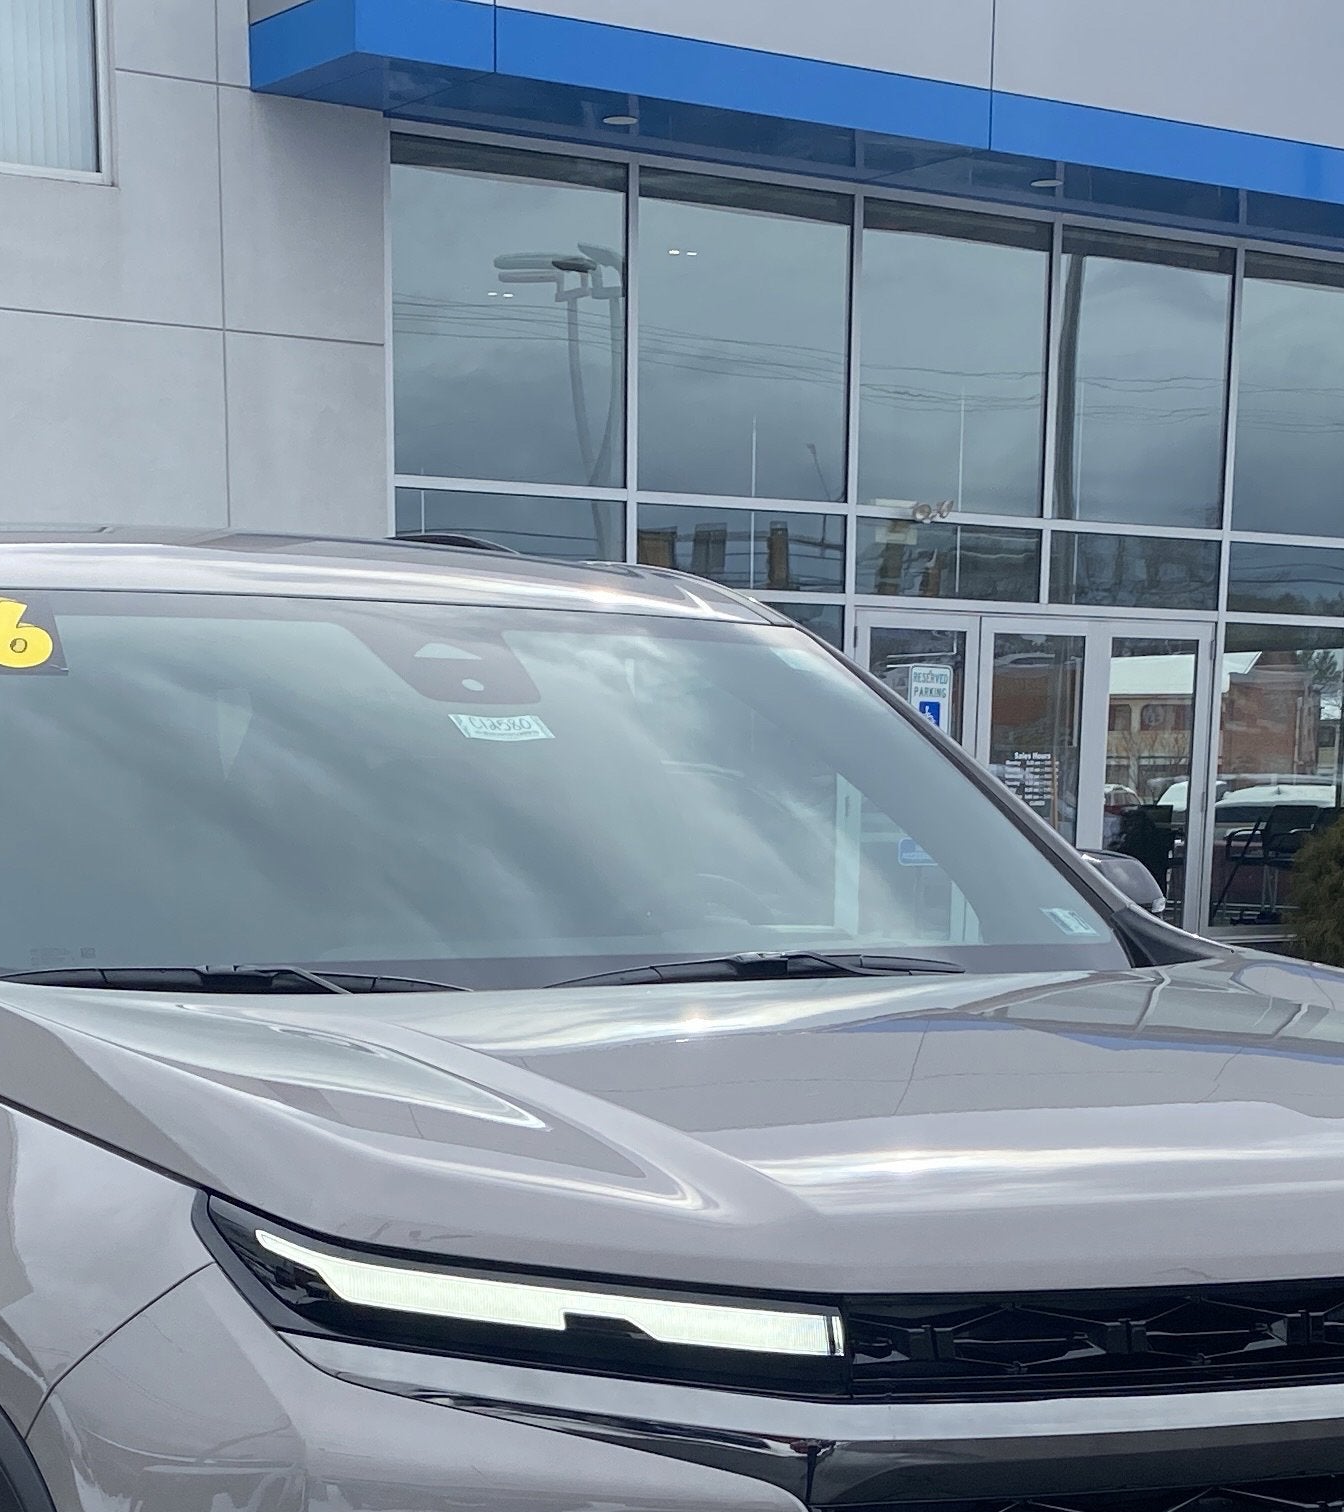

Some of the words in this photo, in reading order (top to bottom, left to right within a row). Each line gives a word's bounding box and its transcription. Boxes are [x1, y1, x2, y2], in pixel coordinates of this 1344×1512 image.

[913, 671, 949, 685] RESERVED
[913, 686, 947, 698] PARKING
[1014, 751, 1032, 760] Sales
[1032, 751, 1052, 760] Hours
